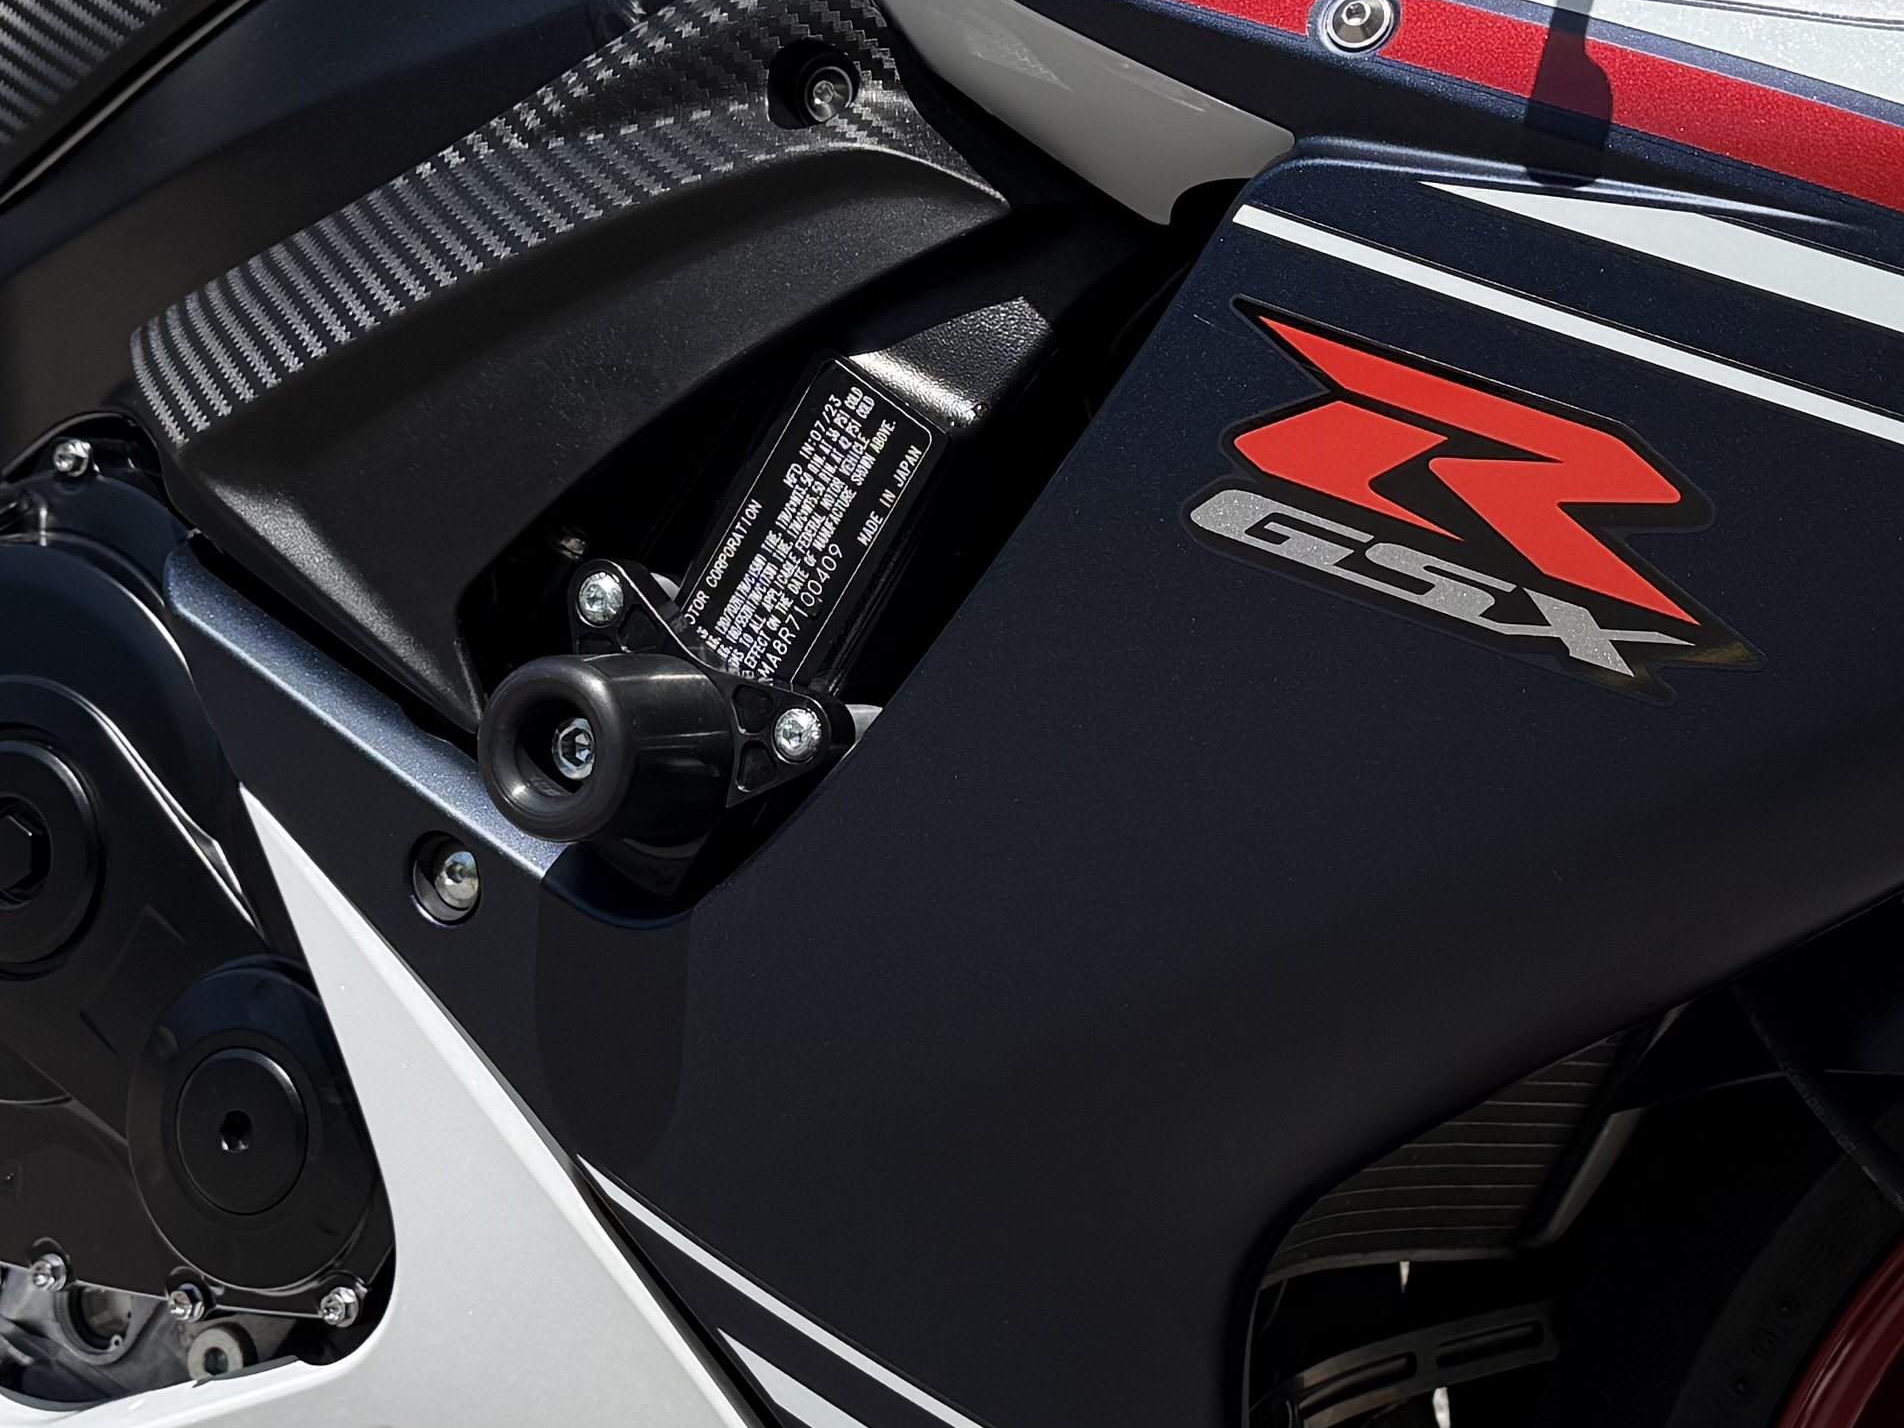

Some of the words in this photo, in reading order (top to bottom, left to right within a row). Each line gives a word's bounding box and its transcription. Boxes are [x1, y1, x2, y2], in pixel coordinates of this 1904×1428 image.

[783, 463, 803, 488] MFD
[819, 439, 833, 455] AT
[833, 409, 851, 429] PSI
[844, 386, 863, 410] COLD
[830, 447, 845, 464] AT
[845, 418, 862, 438] PSI
[855, 395, 875, 419] COLD
[738, 633, 754, 648] TO
[749, 614, 767, 634] ALL
[761, 551, 801, 613] APPLICABLE
[794, 512, 826, 554] FEDERAL
[820, 476, 846, 511] MOTOR
[838, 432, 870, 476] VEHICLE
[743, 630, 771, 669] EFFECT
[766, 614, 781, 631] ON
[774, 593, 794, 615] THE
[787, 566, 809, 595] DATE
[803, 550, 817, 567] OF
[812, 485, 857, 552] MANUFACTURE
[851, 452, 876, 486] SHOWN
[869, 419, 896, 454] ABOVE.
[857, 511, 883, 546] MADE
[879, 489, 896, 508] IN
[893, 445, 922, 487] JAPAN
[684, 590, 710, 625] OTOR
[706, 499, 762, 588] CORPORATION
[1191, 490, 1695, 676] GSX
